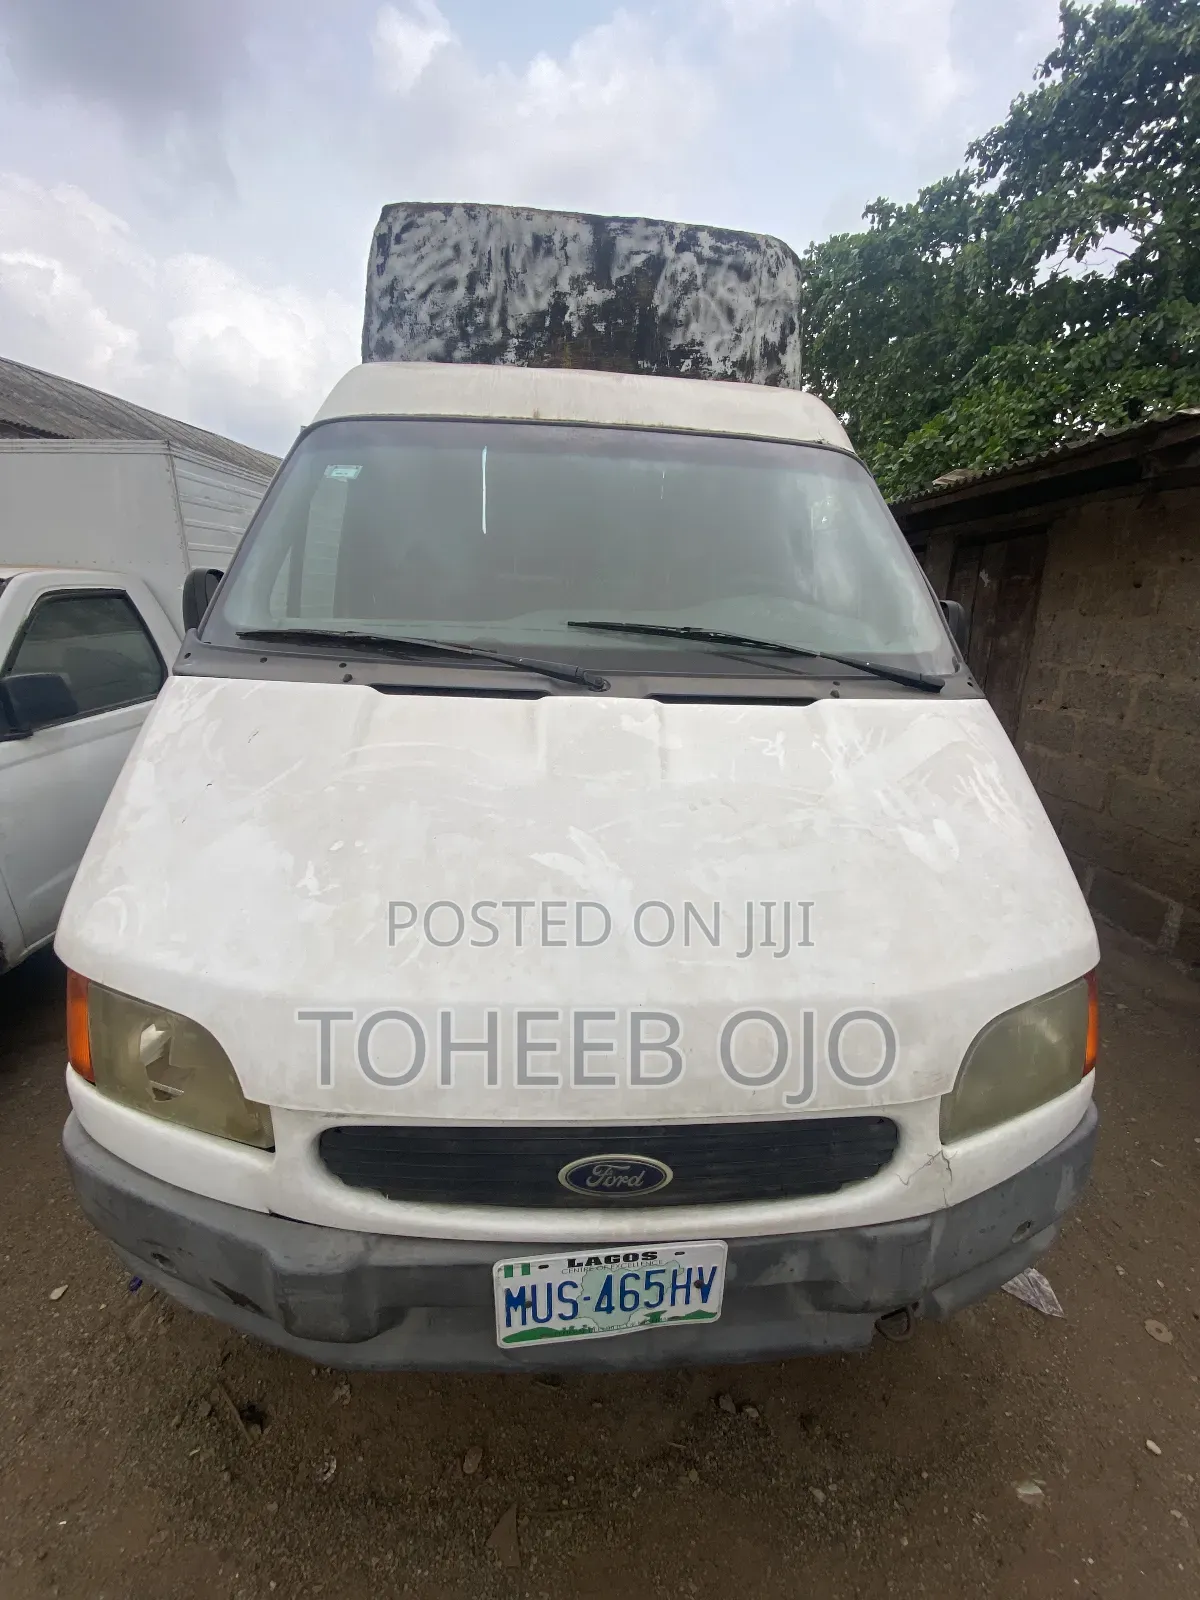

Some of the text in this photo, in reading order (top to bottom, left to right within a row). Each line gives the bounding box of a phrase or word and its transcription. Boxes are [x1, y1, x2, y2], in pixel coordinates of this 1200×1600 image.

[586, 1164, 646, 1187] Ford
[567, 1251, 658, 1268] LAGOS
[504, 1266, 718, 1328] MUS-465HV
